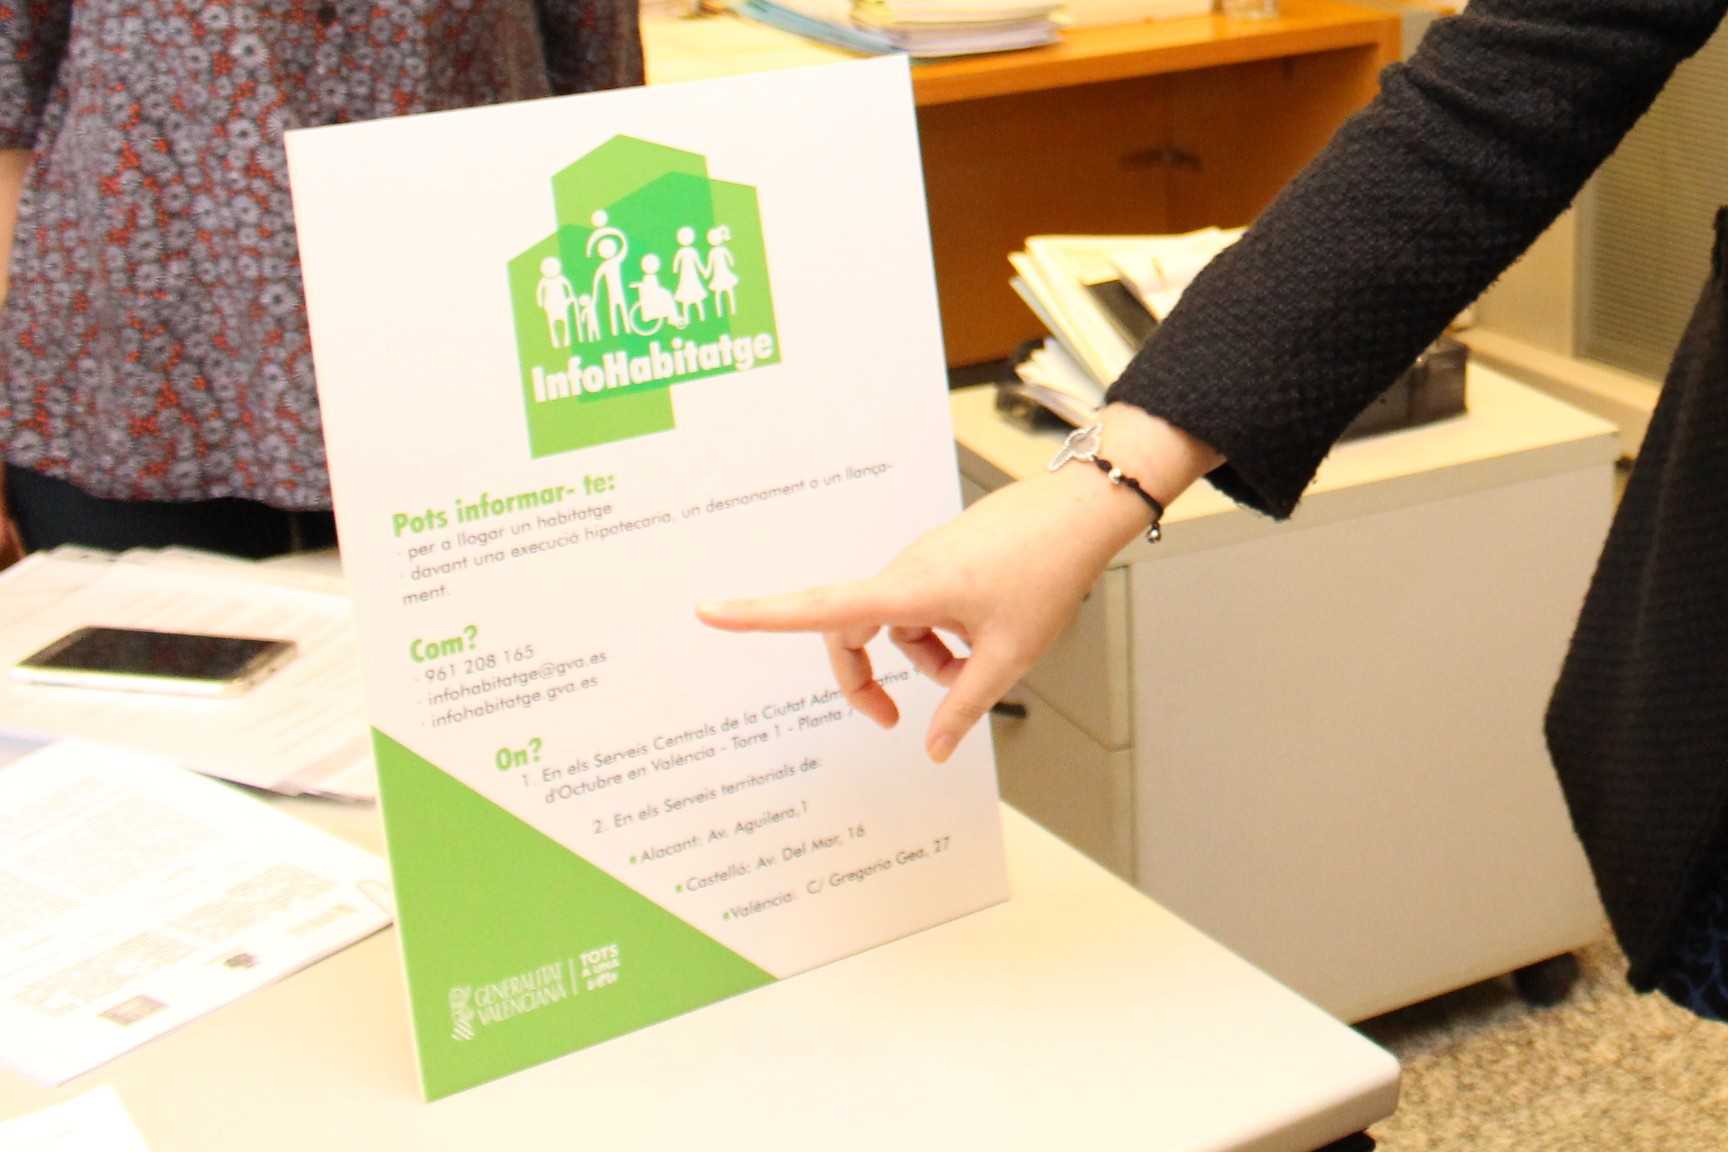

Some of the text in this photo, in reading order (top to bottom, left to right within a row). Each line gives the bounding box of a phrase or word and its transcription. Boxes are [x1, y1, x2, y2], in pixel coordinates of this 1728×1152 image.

[532, 331, 775, 404] InfoHabitatge
[392, 473, 616, 538] Pots informar- te:
[407, 502, 613, 562] per a llogar un habitatge
[411, 557, 468, 581] davant
[474, 549, 505, 567] una
[511, 530, 580, 558] execució
[681, 504, 701, 519] un
[824, 472, 842, 486] un
[409, 624, 478, 663] Com?
[425, 644, 535, 682] 961 208 165
[428, 650, 607, 706] infohabitatge@gva.es
[431, 676, 599, 728] infohabitatge.gva.es
[495, 736, 542, 771] On?
[542, 766, 562, 783] En
[567, 759, 590, 776] els
[593, 743, 648, 768] Serveis
[653, 723, 717, 751] Centrals
[721, 716, 739, 733] de
[743, 711, 757, 725] la
[761, 699, 805, 721] Ciutat
[627, 766, 647, 780] en
[731, 730, 768, 751] Torre
[798, 709, 842, 731] Planta
[613, 812, 633, 828] En
[638, 804, 659, 821] els
[663, 788, 717, 813] Serveis
[721, 763, 795, 795] territorials
[781, 844, 806, 861] Del
[848, 824, 866, 840] 16
[805, 878, 824, 895] C/
[828, 858, 892, 887] Gregorio
[933, 835, 951, 853] 27
[579, 943, 620, 966] TOTS
[474, 961, 563, 1008] GENERALITAT
[477, 982, 568, 1026] VALENCIANA
